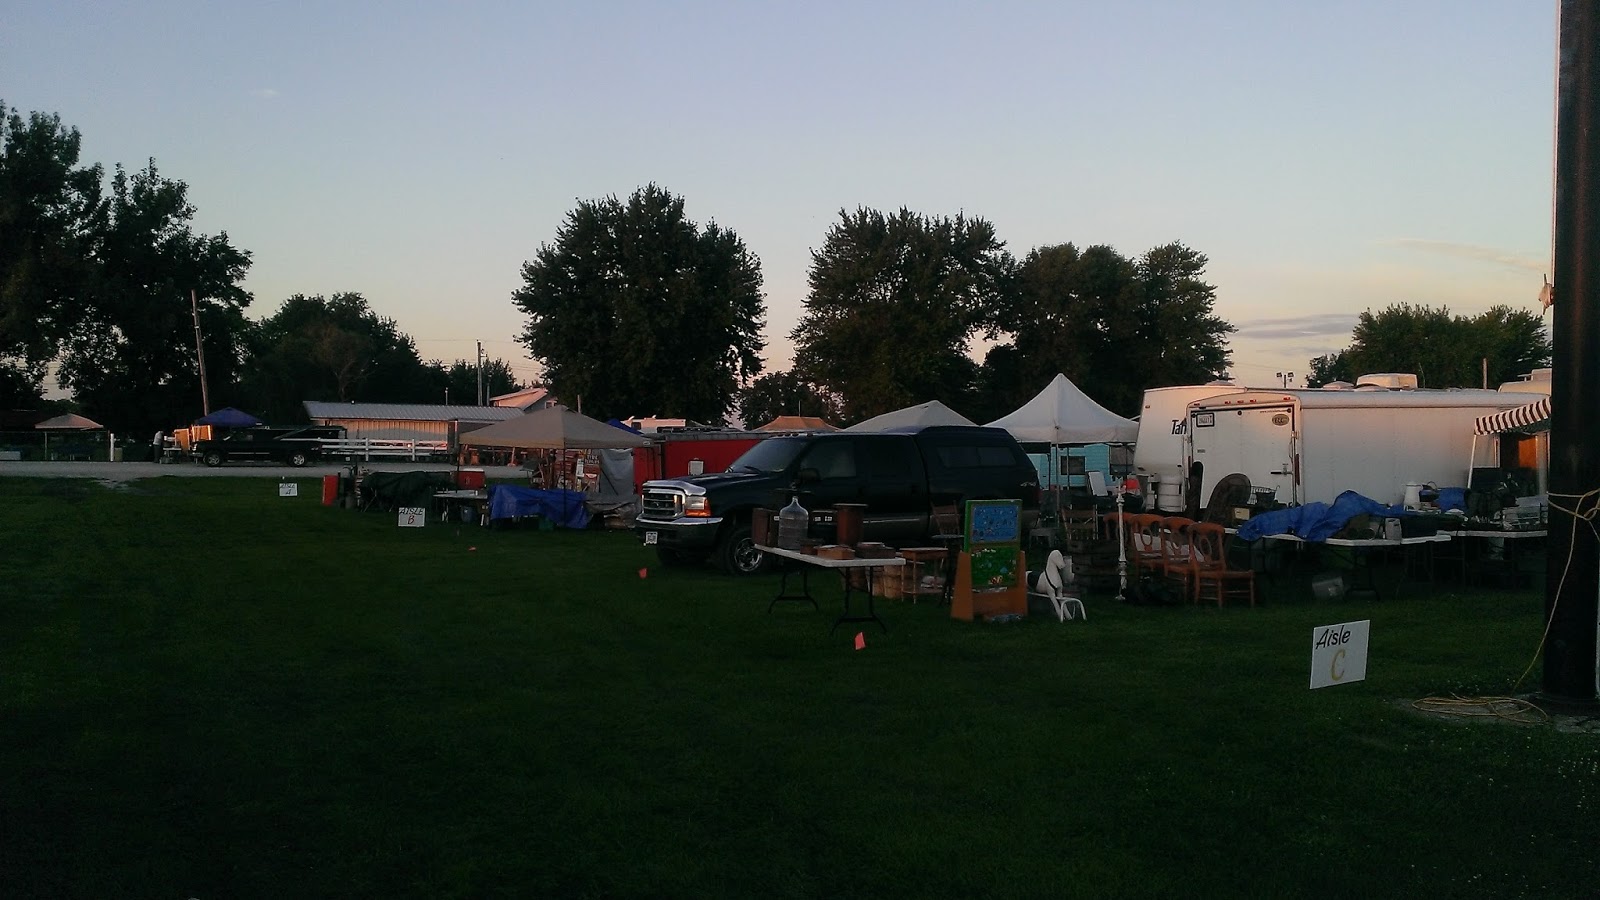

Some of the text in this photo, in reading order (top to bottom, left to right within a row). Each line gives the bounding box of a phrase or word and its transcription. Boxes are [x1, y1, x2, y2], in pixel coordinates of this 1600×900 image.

[407, 515, 415, 525] B
[1315, 624, 1351, 650] Aisle
[1331, 649, 1346, 682] C
